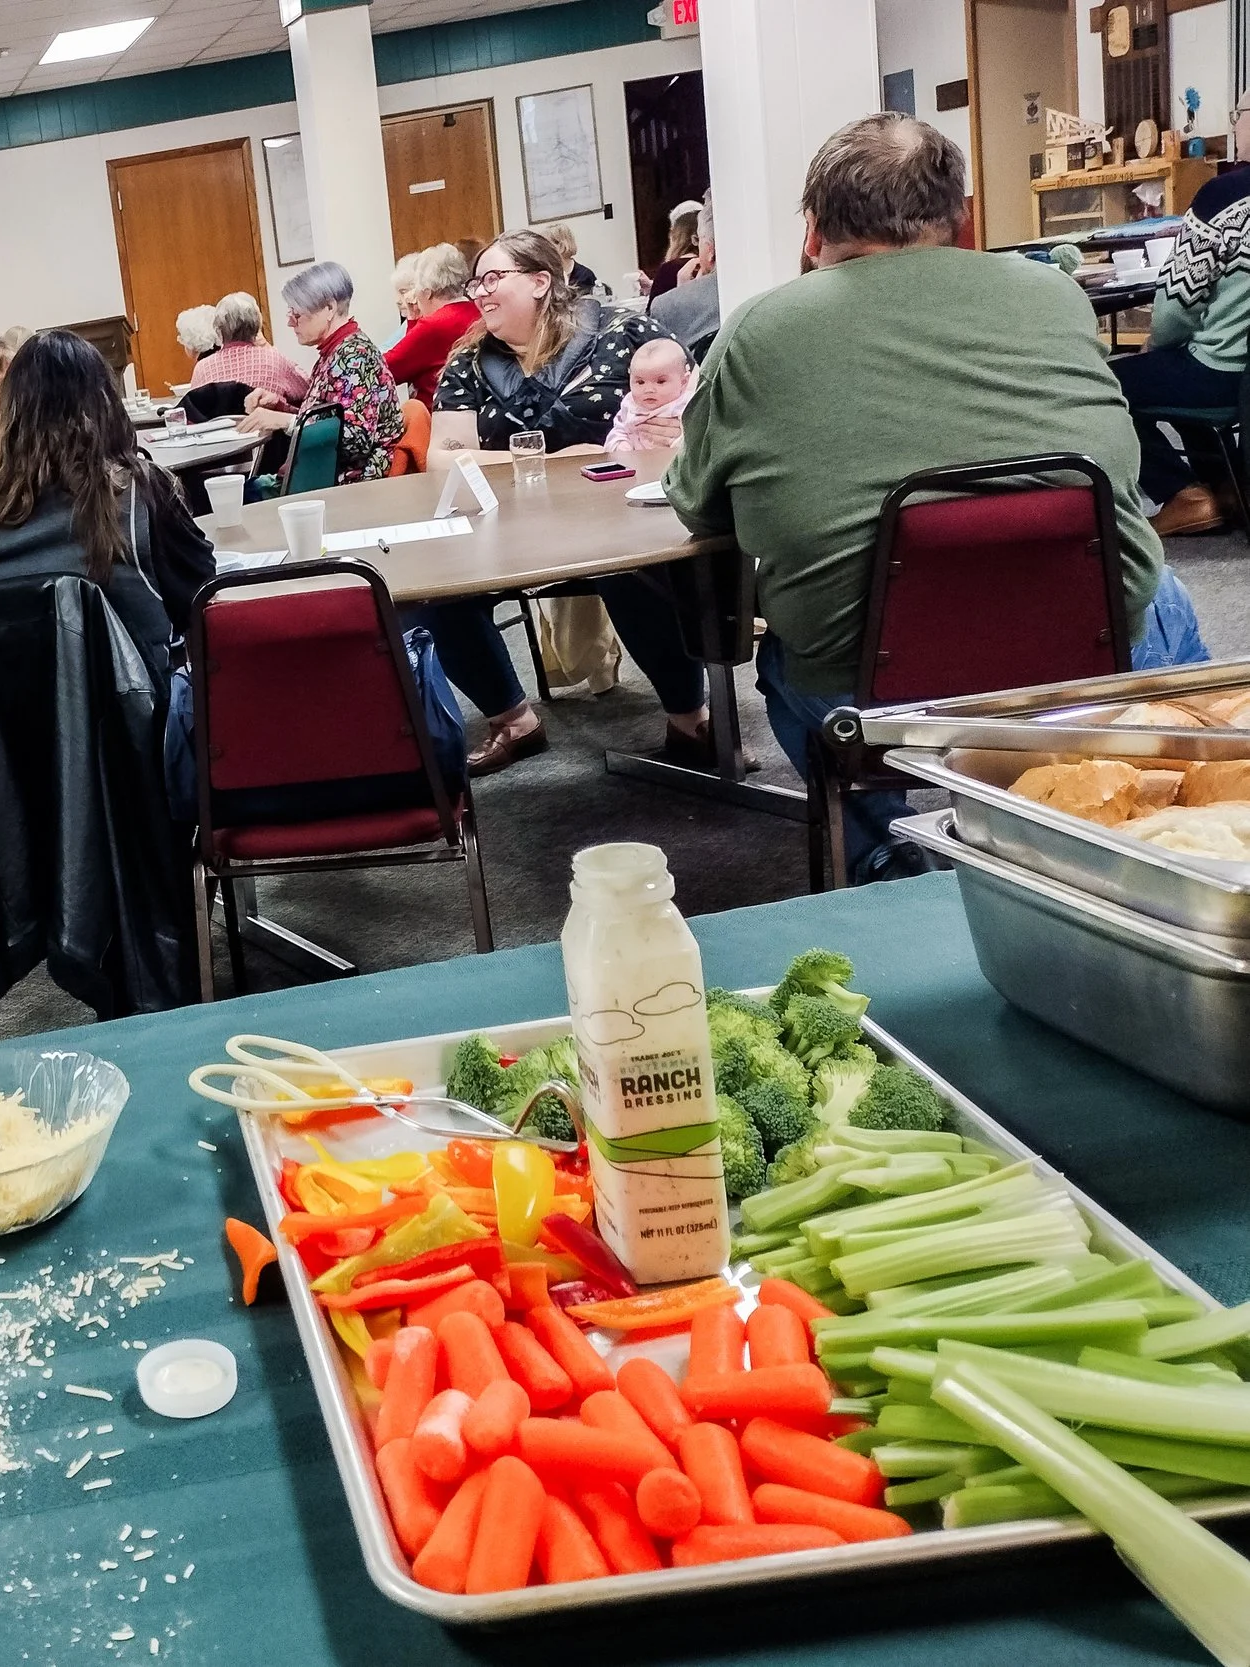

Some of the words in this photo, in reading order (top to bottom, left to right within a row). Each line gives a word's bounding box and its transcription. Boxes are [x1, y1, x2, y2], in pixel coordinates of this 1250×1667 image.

[673, 0, 698, 25] EXI
[631, 1053, 659, 1062] TRADER
[620, 1067, 701, 1097] RANCH
[624, 1089, 702, 1109] DRESSING
[640, 1228, 654, 1239] NET
[657, 1228, 664, 1237] 11
[666, 1227, 673, 1236] FL
[676, 1225, 685, 1234] OZ
